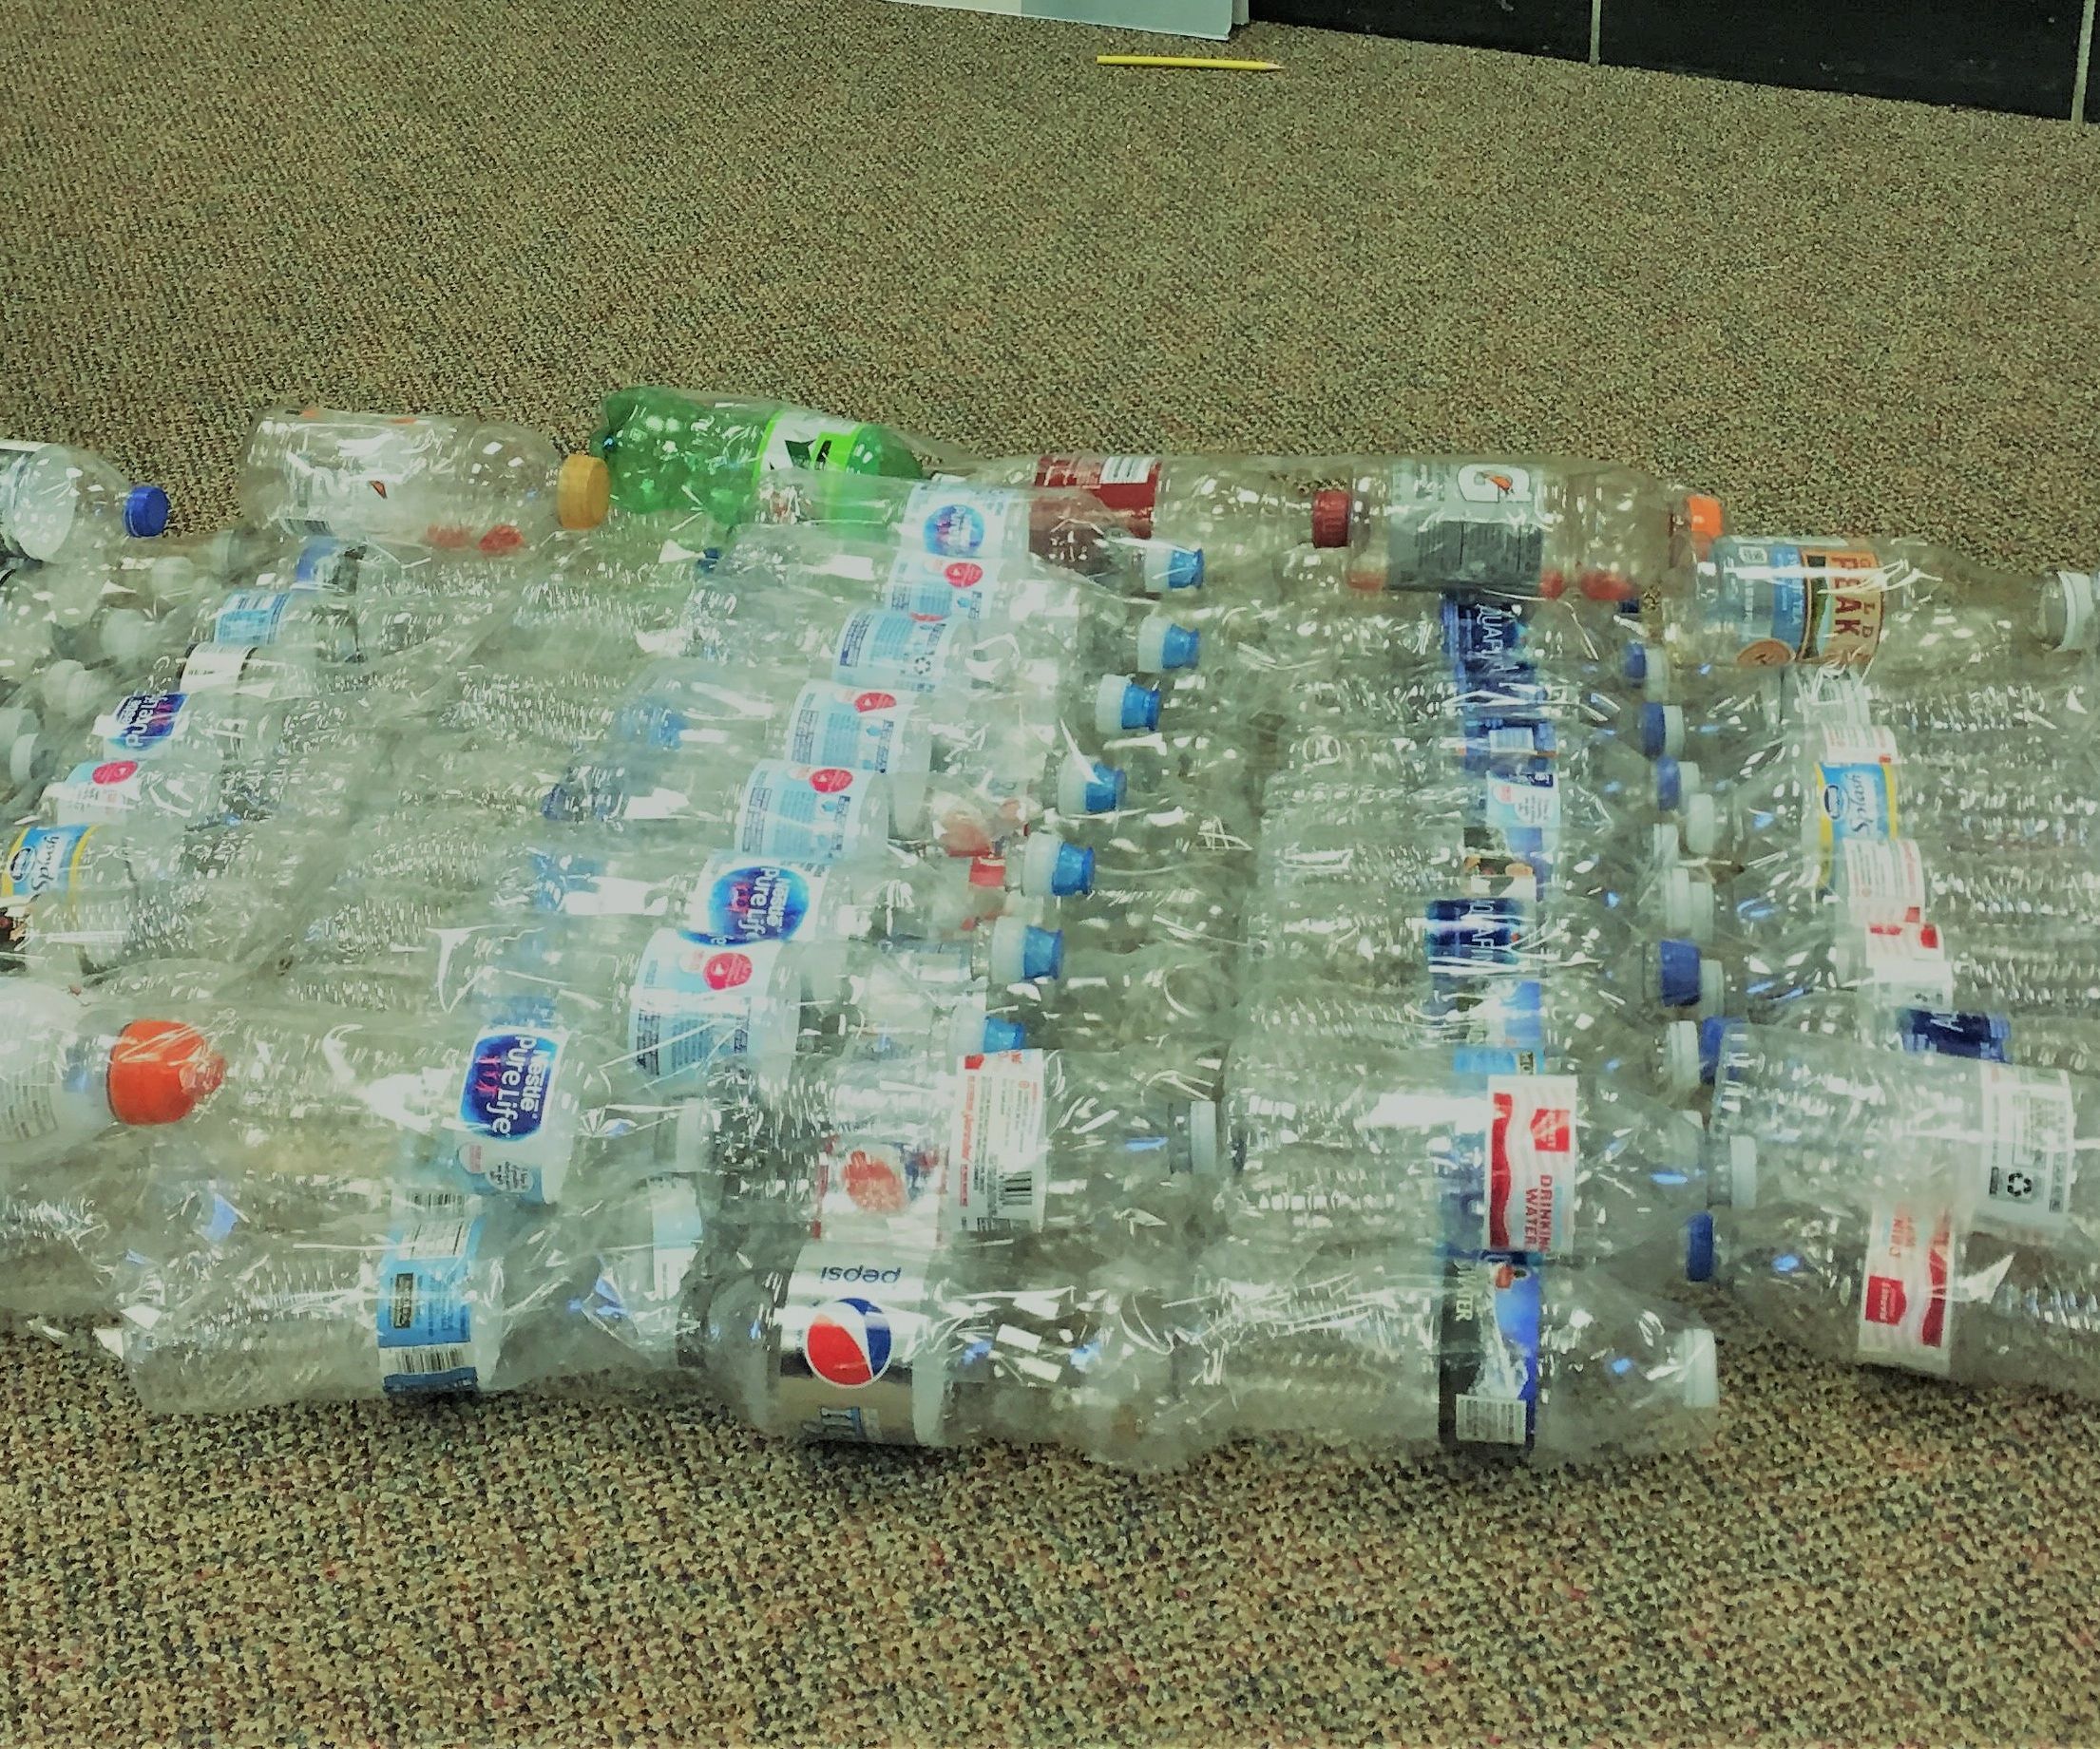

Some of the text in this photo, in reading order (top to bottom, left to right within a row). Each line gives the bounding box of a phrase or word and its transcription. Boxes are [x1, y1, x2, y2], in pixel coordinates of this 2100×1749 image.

[486, 1088, 520, 1135] Life
[1523, 1188, 1538, 1245] WATER
[820, 1264, 903, 1284] pepsi
